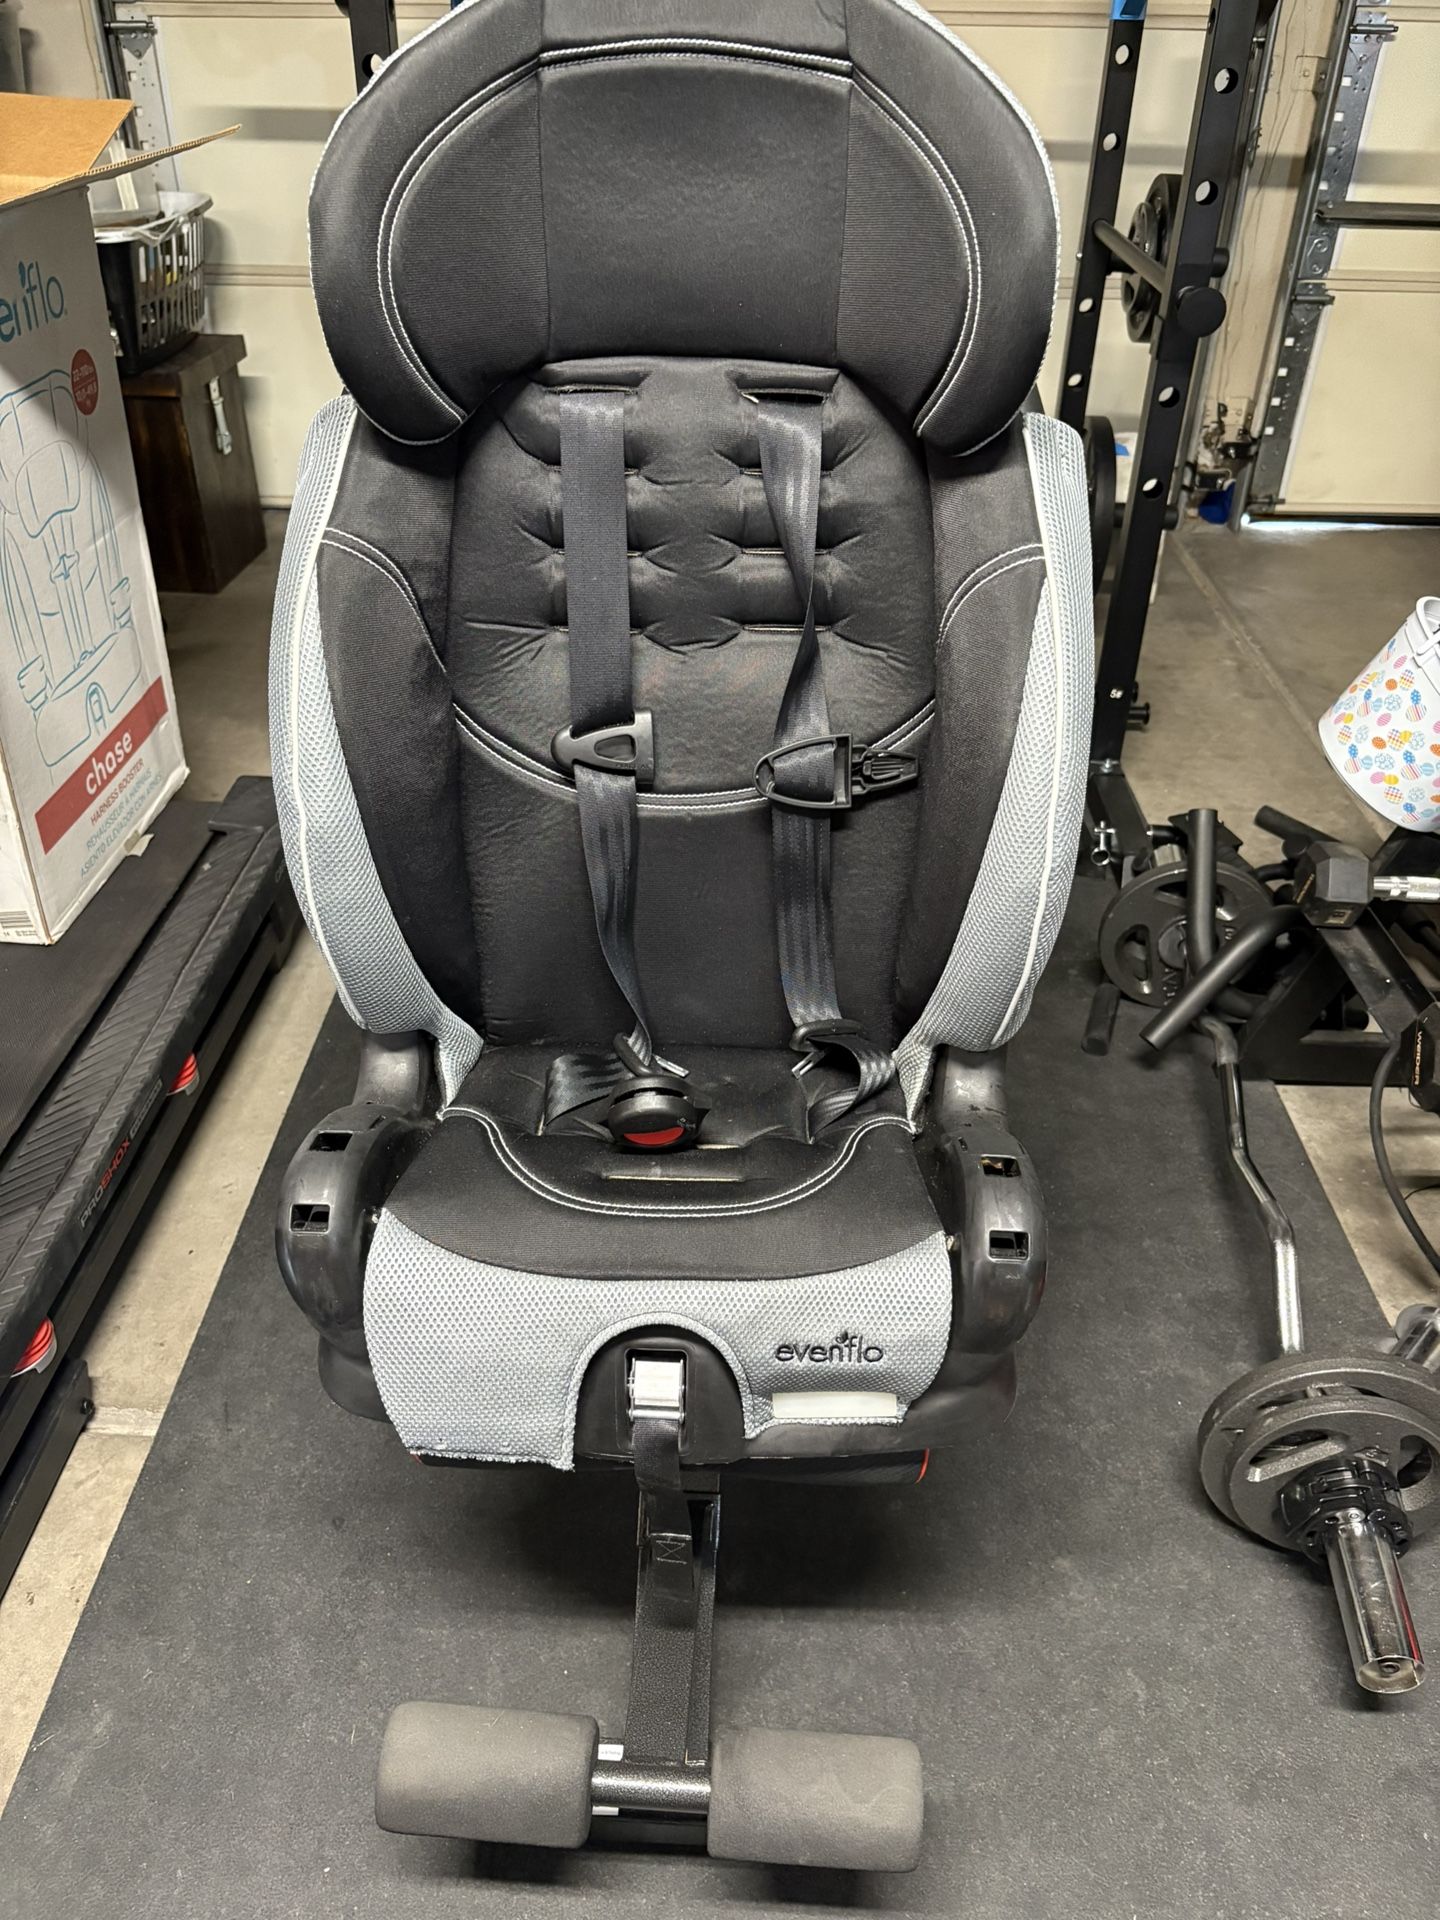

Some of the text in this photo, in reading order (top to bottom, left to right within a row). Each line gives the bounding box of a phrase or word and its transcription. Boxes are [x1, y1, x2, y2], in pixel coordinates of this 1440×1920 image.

[85, 731, 133, 796] chase
[90, 758, 144, 826] HARNESS BOOSTER
[80, 1137, 130, 1228] PROSHOX
[775, 1331, 884, 1363] evenflo
